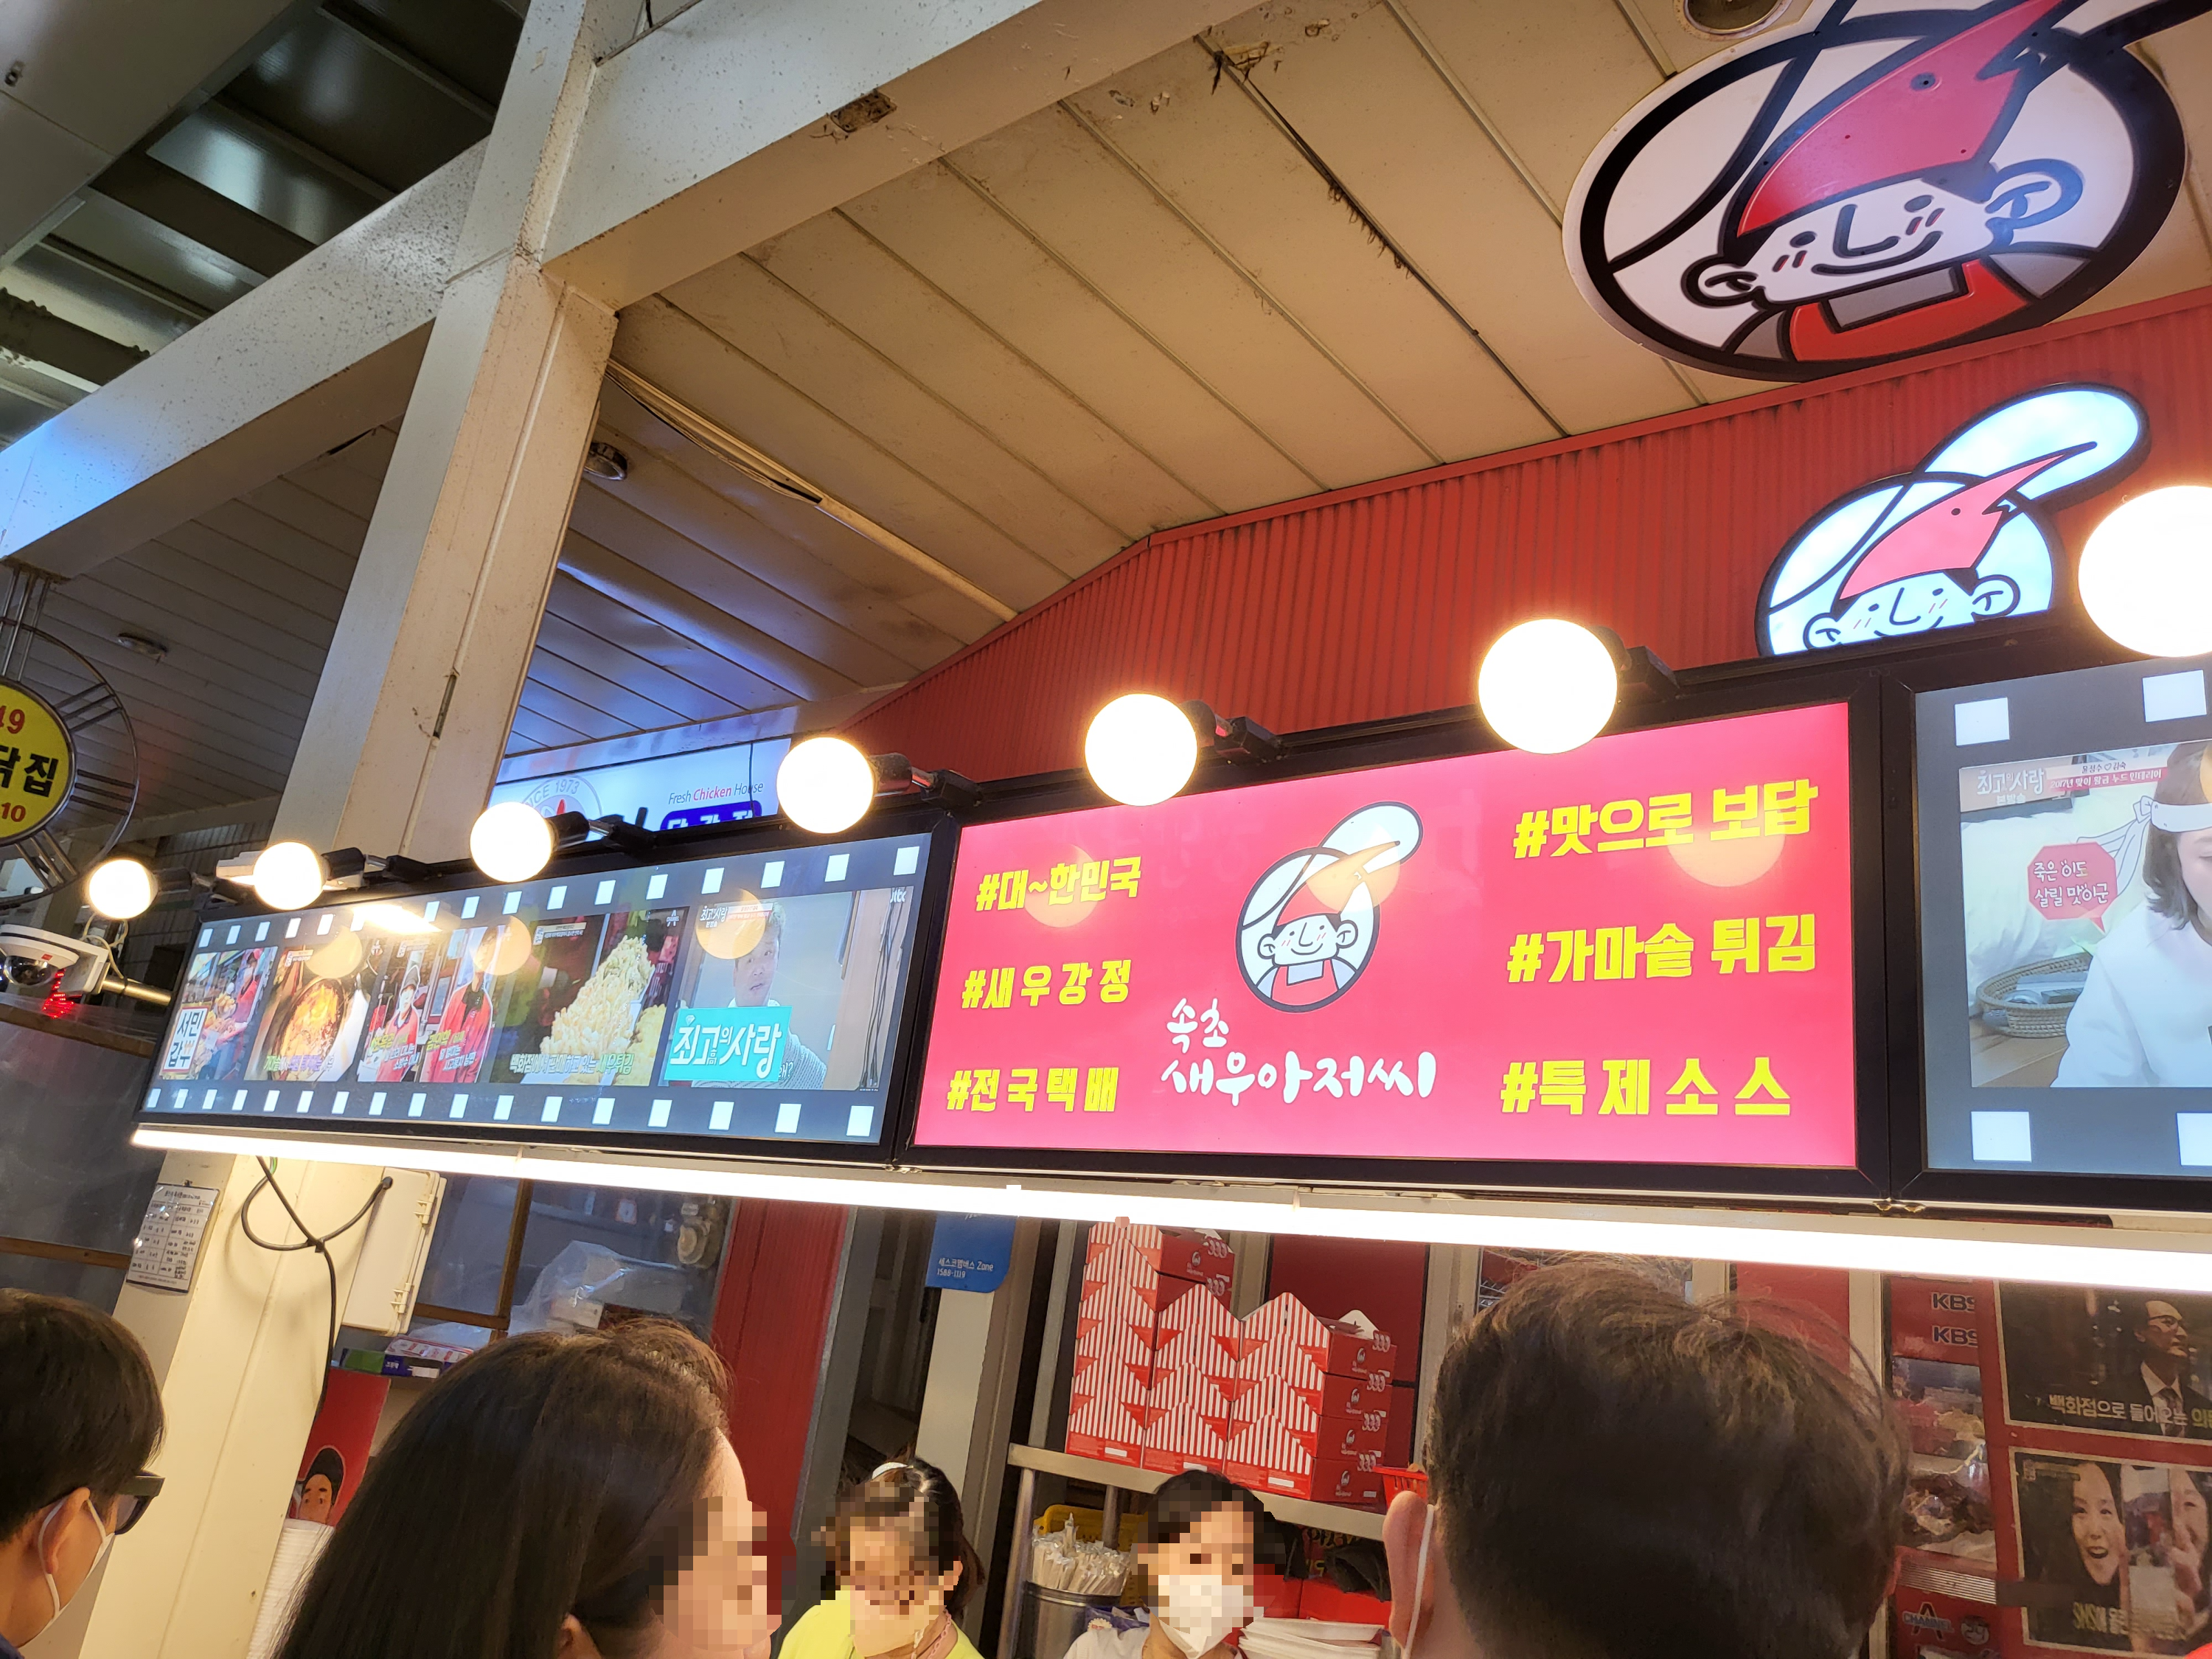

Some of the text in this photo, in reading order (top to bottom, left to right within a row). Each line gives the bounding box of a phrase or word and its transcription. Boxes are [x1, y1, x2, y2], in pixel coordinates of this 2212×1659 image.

[555, 779, 580, 795] 1973
[668, 782, 764, 805] Fresh Chicken House
[1512, 778, 1819, 859] #맛으로 보답
[2034, 859, 2089, 883] 죽은 이도
[2034, 883, 2110, 908] 살릴 맛이군
[1506, 914, 1816, 984] #가마솥 튀김
[961, 959, 1133, 1009] #새우강정
[177, 1010, 204, 1038] 서민
[1166, 998, 1230, 1054] 속초
[509, 1053, 549, 1074] 백화점에서
[580, 1054, 598, 1074] 있는
[947, 1065, 1120, 1113] #전국택배
[1161, 1051, 1437, 1107] 새우아저씨
[1500, 1057, 1791, 1116] #특제소스
[936, 1267, 966, 1279] 1588-1119
[938, 1257, 994, 1272] 세스코멤버스 Zone
[2048, 1394, 2127, 1420] 백화점으로
[2129, 1402, 2188, 1427] 들어오는
